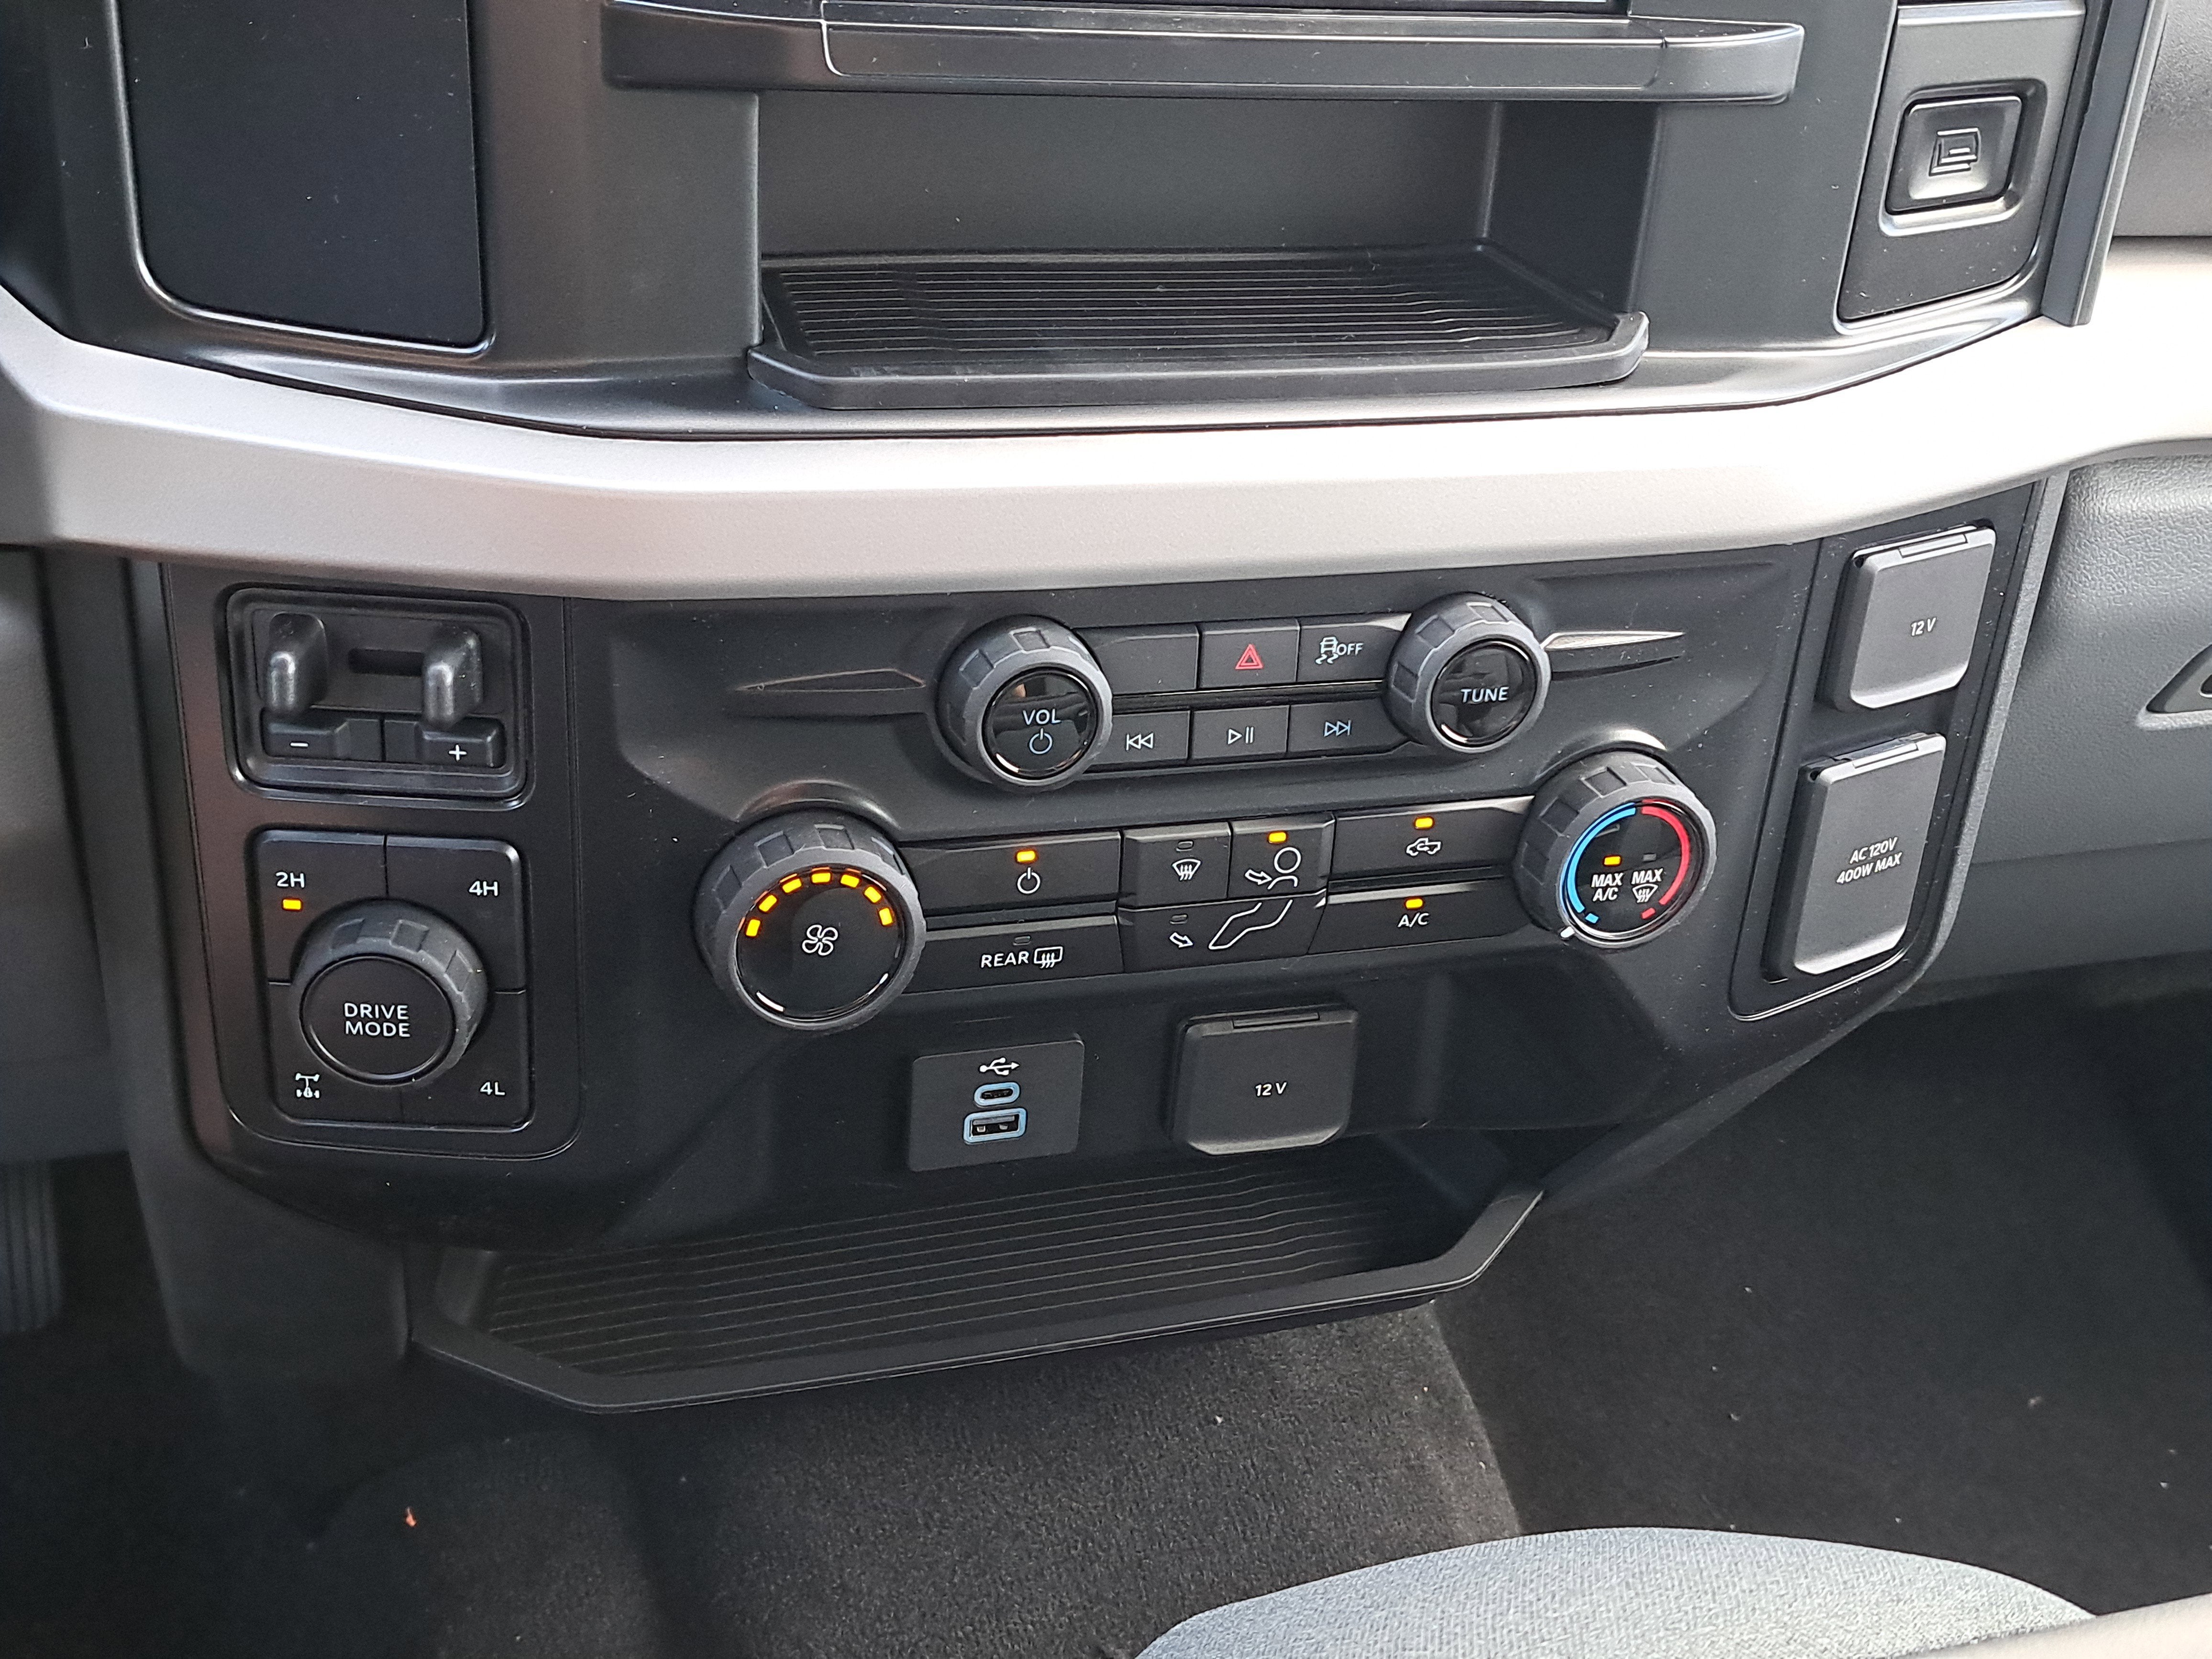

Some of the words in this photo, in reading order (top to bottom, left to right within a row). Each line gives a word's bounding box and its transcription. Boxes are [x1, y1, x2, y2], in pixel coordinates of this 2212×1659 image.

[1911, 620, 1924, 636] 12
[1927, 617, 1936, 632] V
[1337, 642, 1364, 656] OFF
[1460, 686, 1509, 703] TUNE
[1023, 708, 1061, 725] VOL
[1849, 847, 1868, 864] AC
[1869, 837, 1898, 858] 120V
[1631, 868, 1663, 885] MAX
[1836, 863, 1874, 884] 400W
[1874, 852, 1902, 873] MAX
[276, 872, 305, 888] 2H
[469, 881, 498, 896] 4H
[1591, 873, 1623, 887] MAX
[1593, 887, 1618, 902] A/C
[1397, 912, 1429, 928] A/C
[981, 951, 1029, 968] REAR
[344, 1003, 409, 1020] DRIVE
[345, 1020, 410, 1038] MODE
[480, 1082, 505, 1095] 4L
[1255, 1084, 1272, 1096] 12
[1275, 1082, 1287, 1094] V
